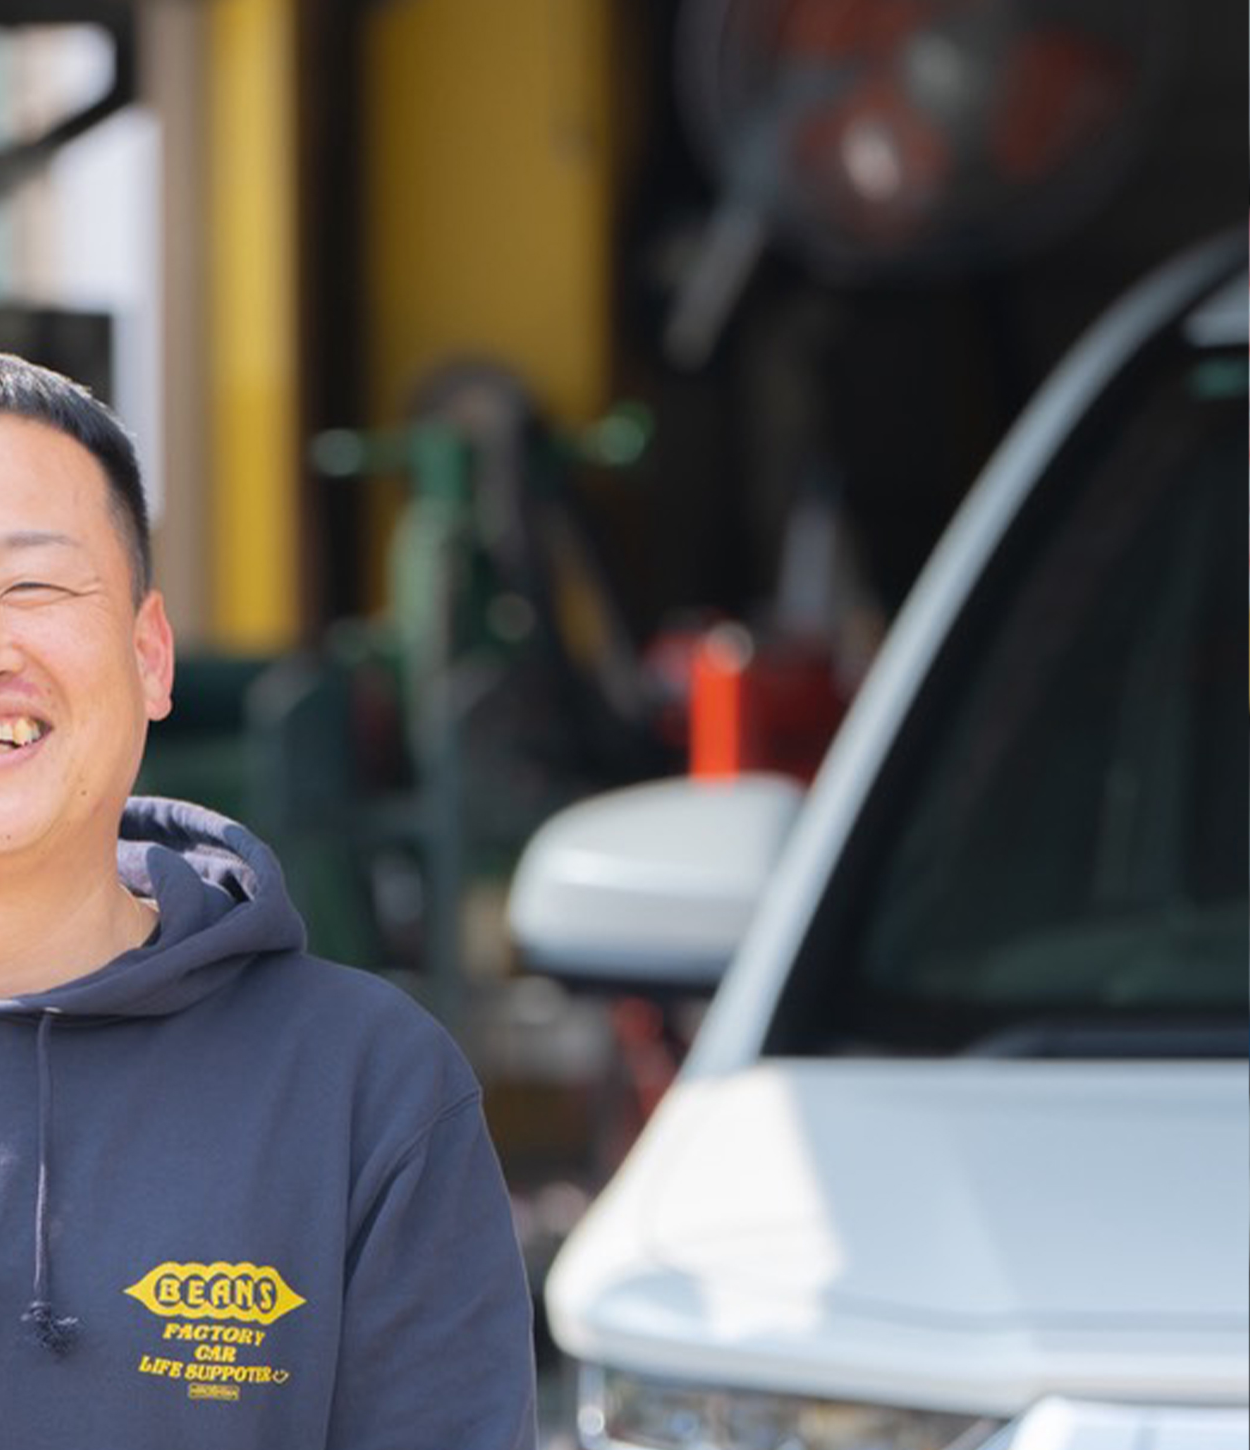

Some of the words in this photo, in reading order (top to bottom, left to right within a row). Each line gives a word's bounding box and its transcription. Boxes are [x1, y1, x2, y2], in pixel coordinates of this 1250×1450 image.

[158, 1278, 272, 1311] BEANS
[163, 1323, 265, 1346] FACTORY
[194, 1344, 237, 1363] CAR
[138, 1355, 183, 1378] LIFE
[184, 1363, 272, 1382] SUPPOTER
